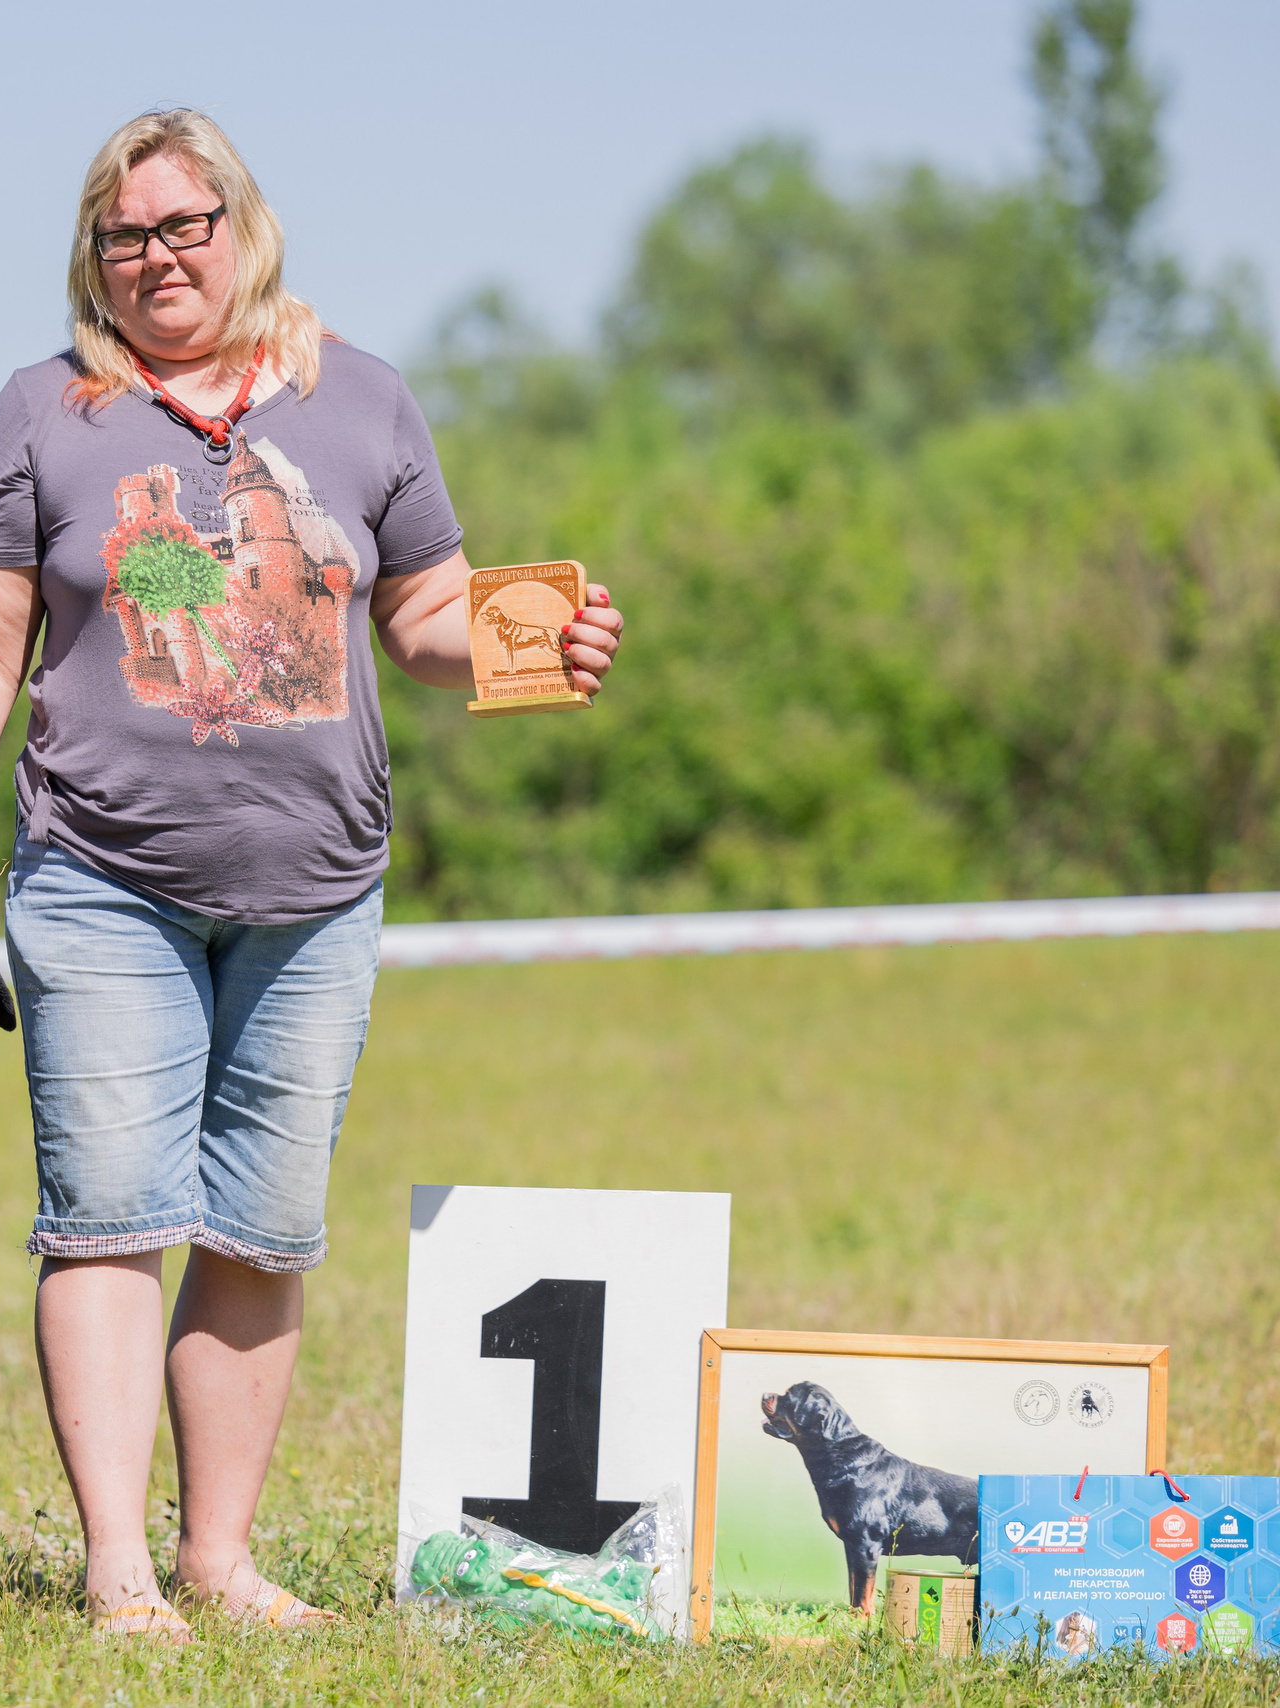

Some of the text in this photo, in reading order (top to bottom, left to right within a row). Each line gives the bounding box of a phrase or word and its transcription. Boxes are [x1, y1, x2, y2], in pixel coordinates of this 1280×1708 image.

[475, 565, 572, 585] ПОБЕДИТЕЛЬ КЛАССА
[482, 682, 575, 699] Воронежские встречи
[461, 1277, 656, 1563] 1
[1016, 1520, 1089, 1547] АВЗ
[1054, 1568, 1145, 1578] МЫ ПРОИЗВОДИМ
[1068, 1579, 1130, 1588] ЛЕКАРСТВА
[1033, 1591, 1166, 1601] И ДЕЛАЕМ ЭТО ХОРОШО!
